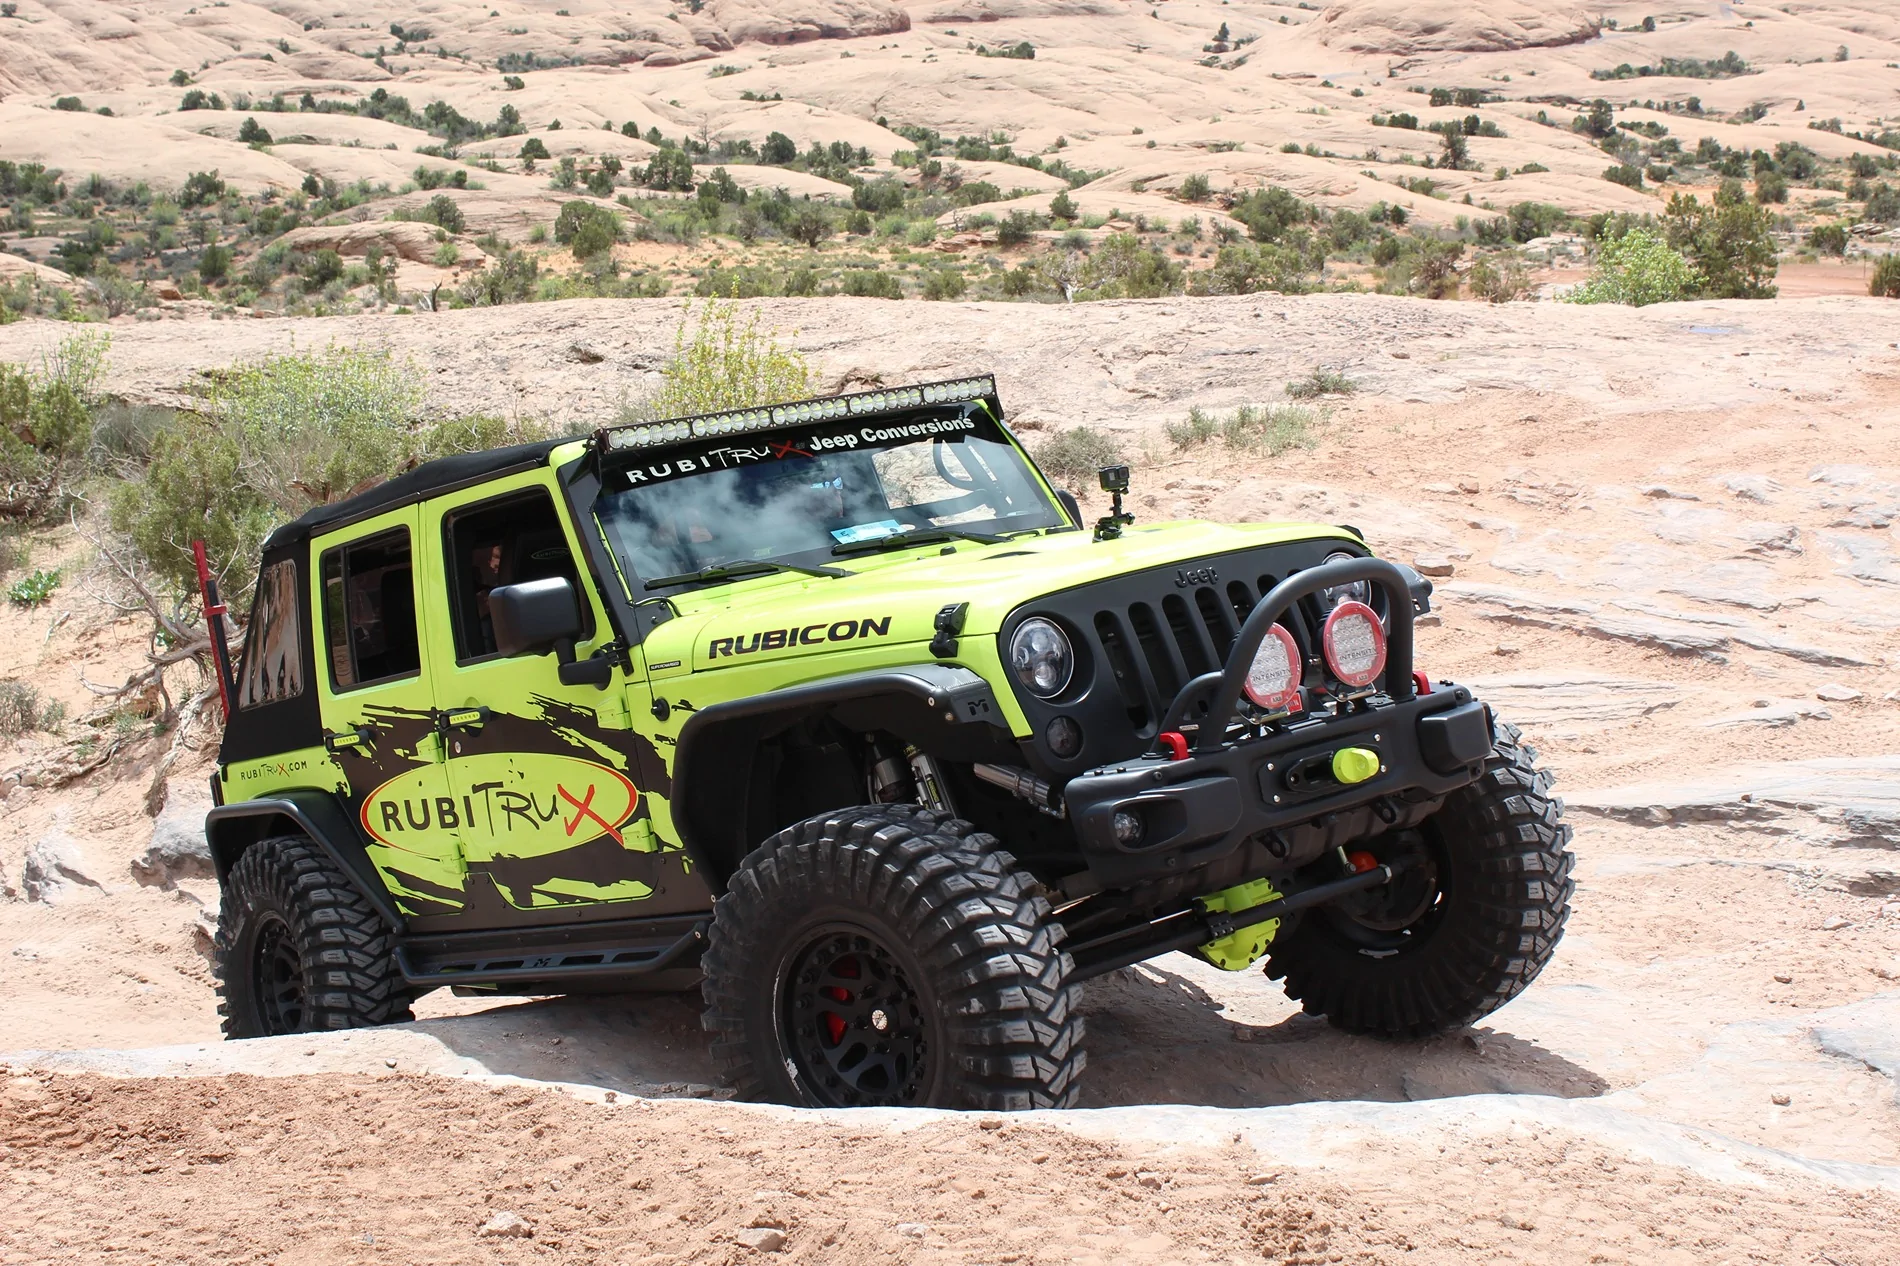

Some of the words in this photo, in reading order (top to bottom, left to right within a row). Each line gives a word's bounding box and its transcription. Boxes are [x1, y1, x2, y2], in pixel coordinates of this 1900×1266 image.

[809, 431, 859, 453] Jeep
[860, 415, 975, 443] Conversions
[1174, 566, 1219, 588] Jeep
[709, 616, 892, 660] RUBICON
